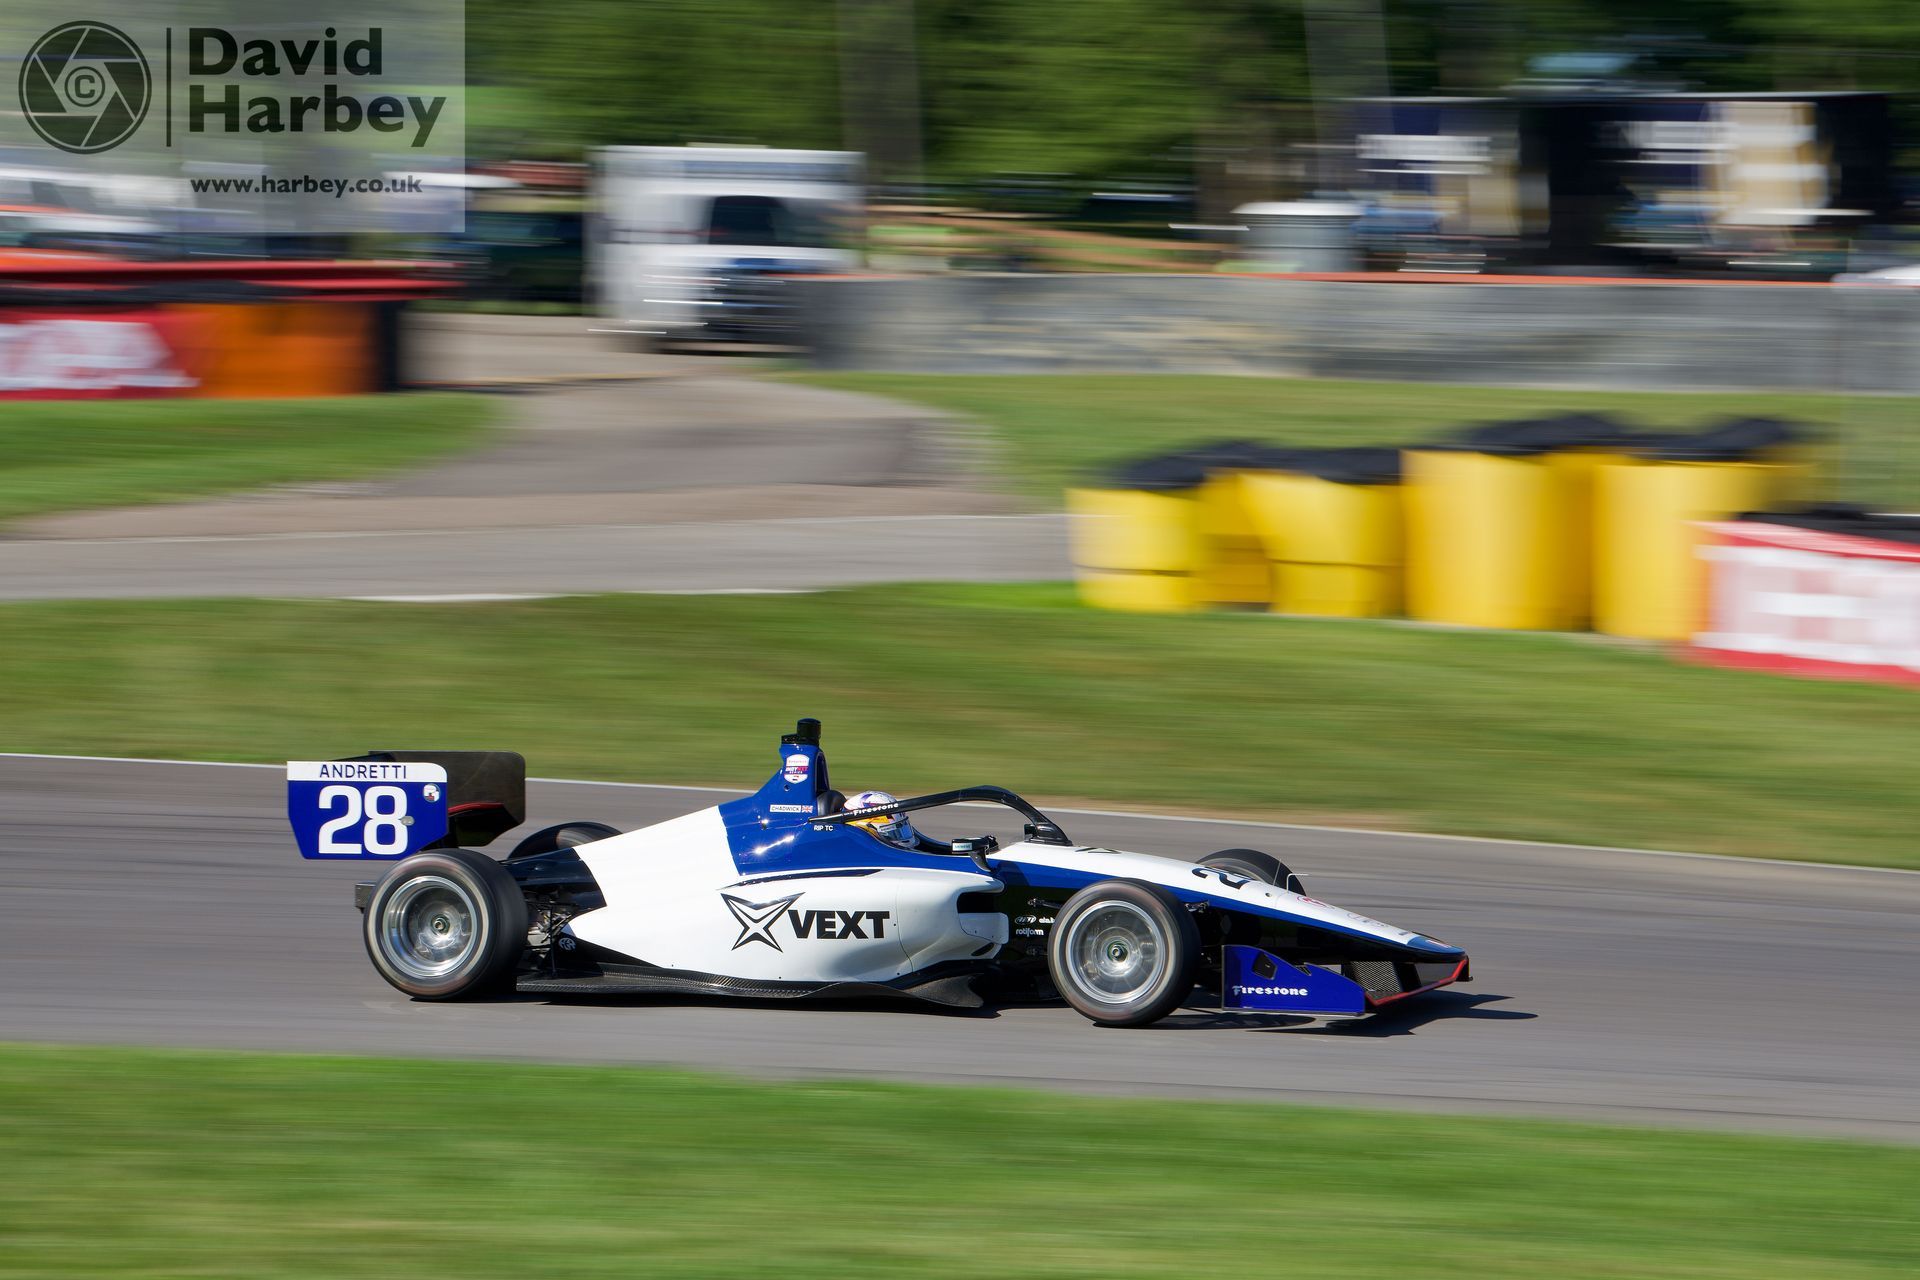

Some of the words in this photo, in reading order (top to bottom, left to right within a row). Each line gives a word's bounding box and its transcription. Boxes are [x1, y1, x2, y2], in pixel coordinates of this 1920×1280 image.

[319, 764, 407, 779] ANDRETTI
[853, 802, 899, 816] Firestone
[318, 785, 409, 855] 28
[787, 909, 890, 939] VEXT
[1231, 985, 1309, 996] Firestone
